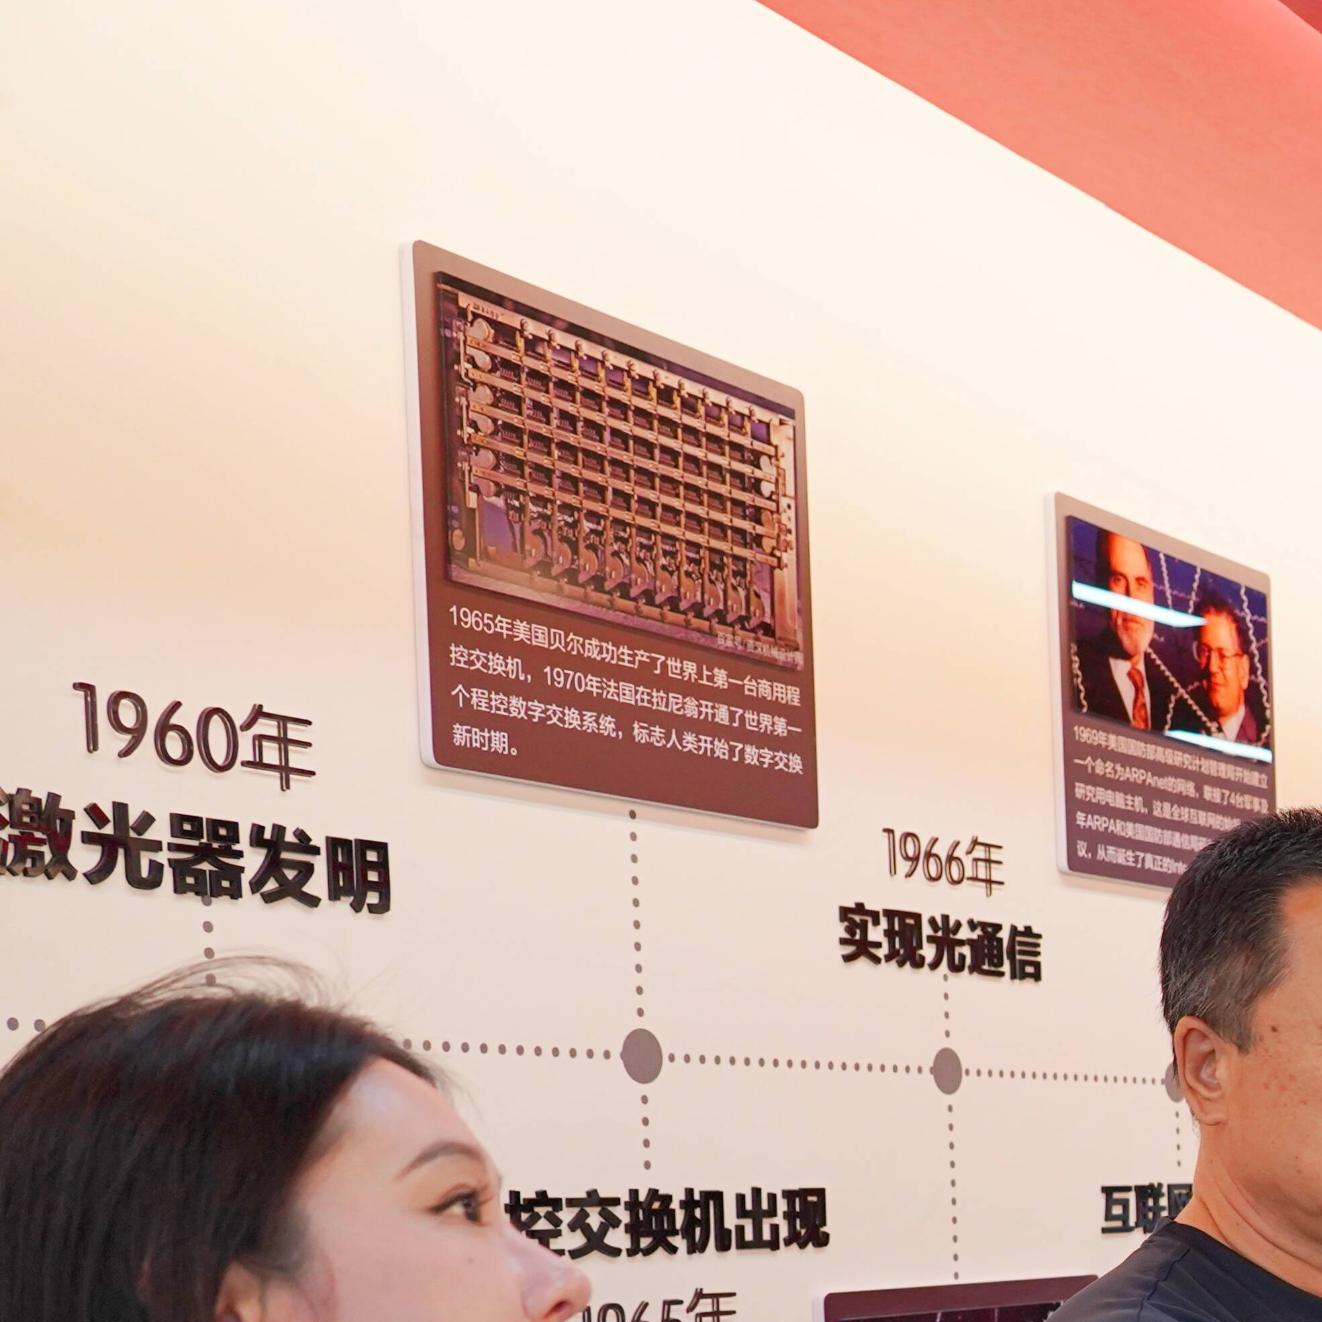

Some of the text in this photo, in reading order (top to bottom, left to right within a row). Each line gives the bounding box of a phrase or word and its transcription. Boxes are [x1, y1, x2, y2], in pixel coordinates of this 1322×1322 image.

[449, 605, 801, 707] 1965年美国贝尔成功生产了世界上第一台商用程
[72, 682, 316, 791] 1960年
[452, 723, 519, 756] 新时期。
[0, 787, 391, 914] 激光器发明
[882, 828, 1005, 895] 1966年
[838, 902, 1042, 983] 实现光通信
[504, 1187, 830, 1260] 控交换机出现
